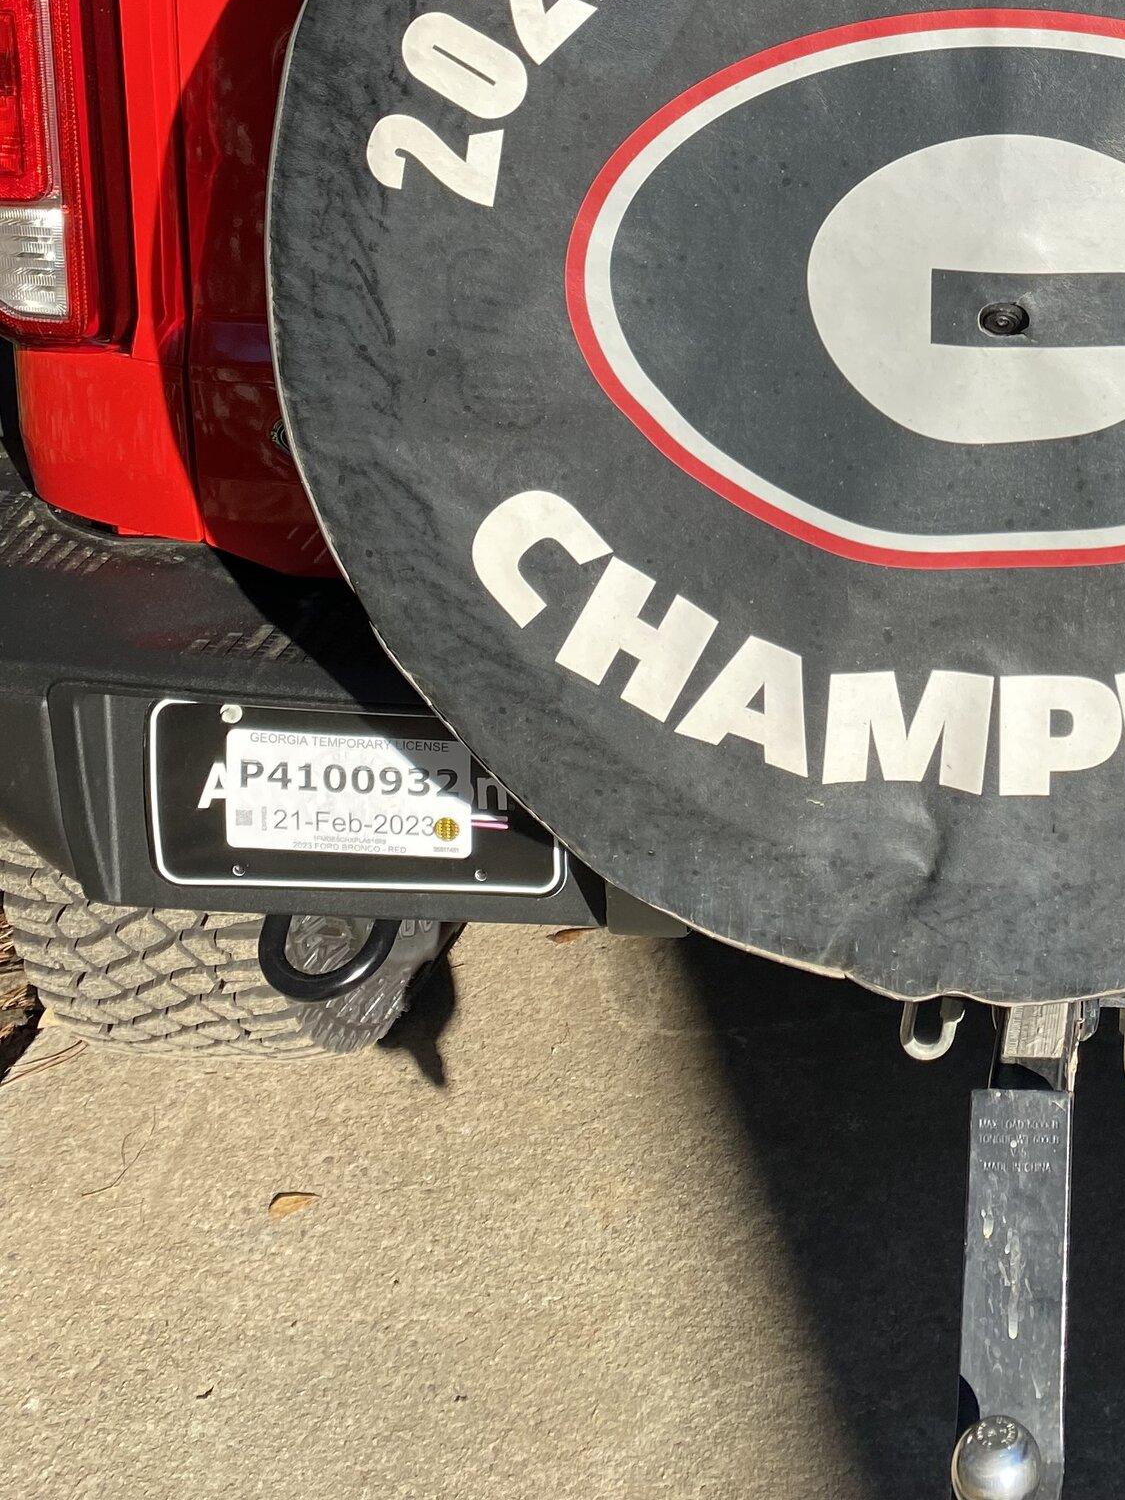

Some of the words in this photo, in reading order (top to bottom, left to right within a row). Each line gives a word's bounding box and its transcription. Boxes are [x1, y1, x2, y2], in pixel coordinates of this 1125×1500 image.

[250, 732, 307, 746] GEORGIA
[313, 736, 392, 750] TEMPORARY
[395, 740, 450, 752] LICENSE
[239, 758, 460, 798] P4100932
[273, 808, 435, 837] 21-Feb-2023
[292, 841, 312, 849] 2023
[314, 842, 339, 851] FORD
[342, 844, 380, 852] BRONCO
[388, 845, 407, 853] RED
[1023, 1161, 1052, 1173] CHINA
